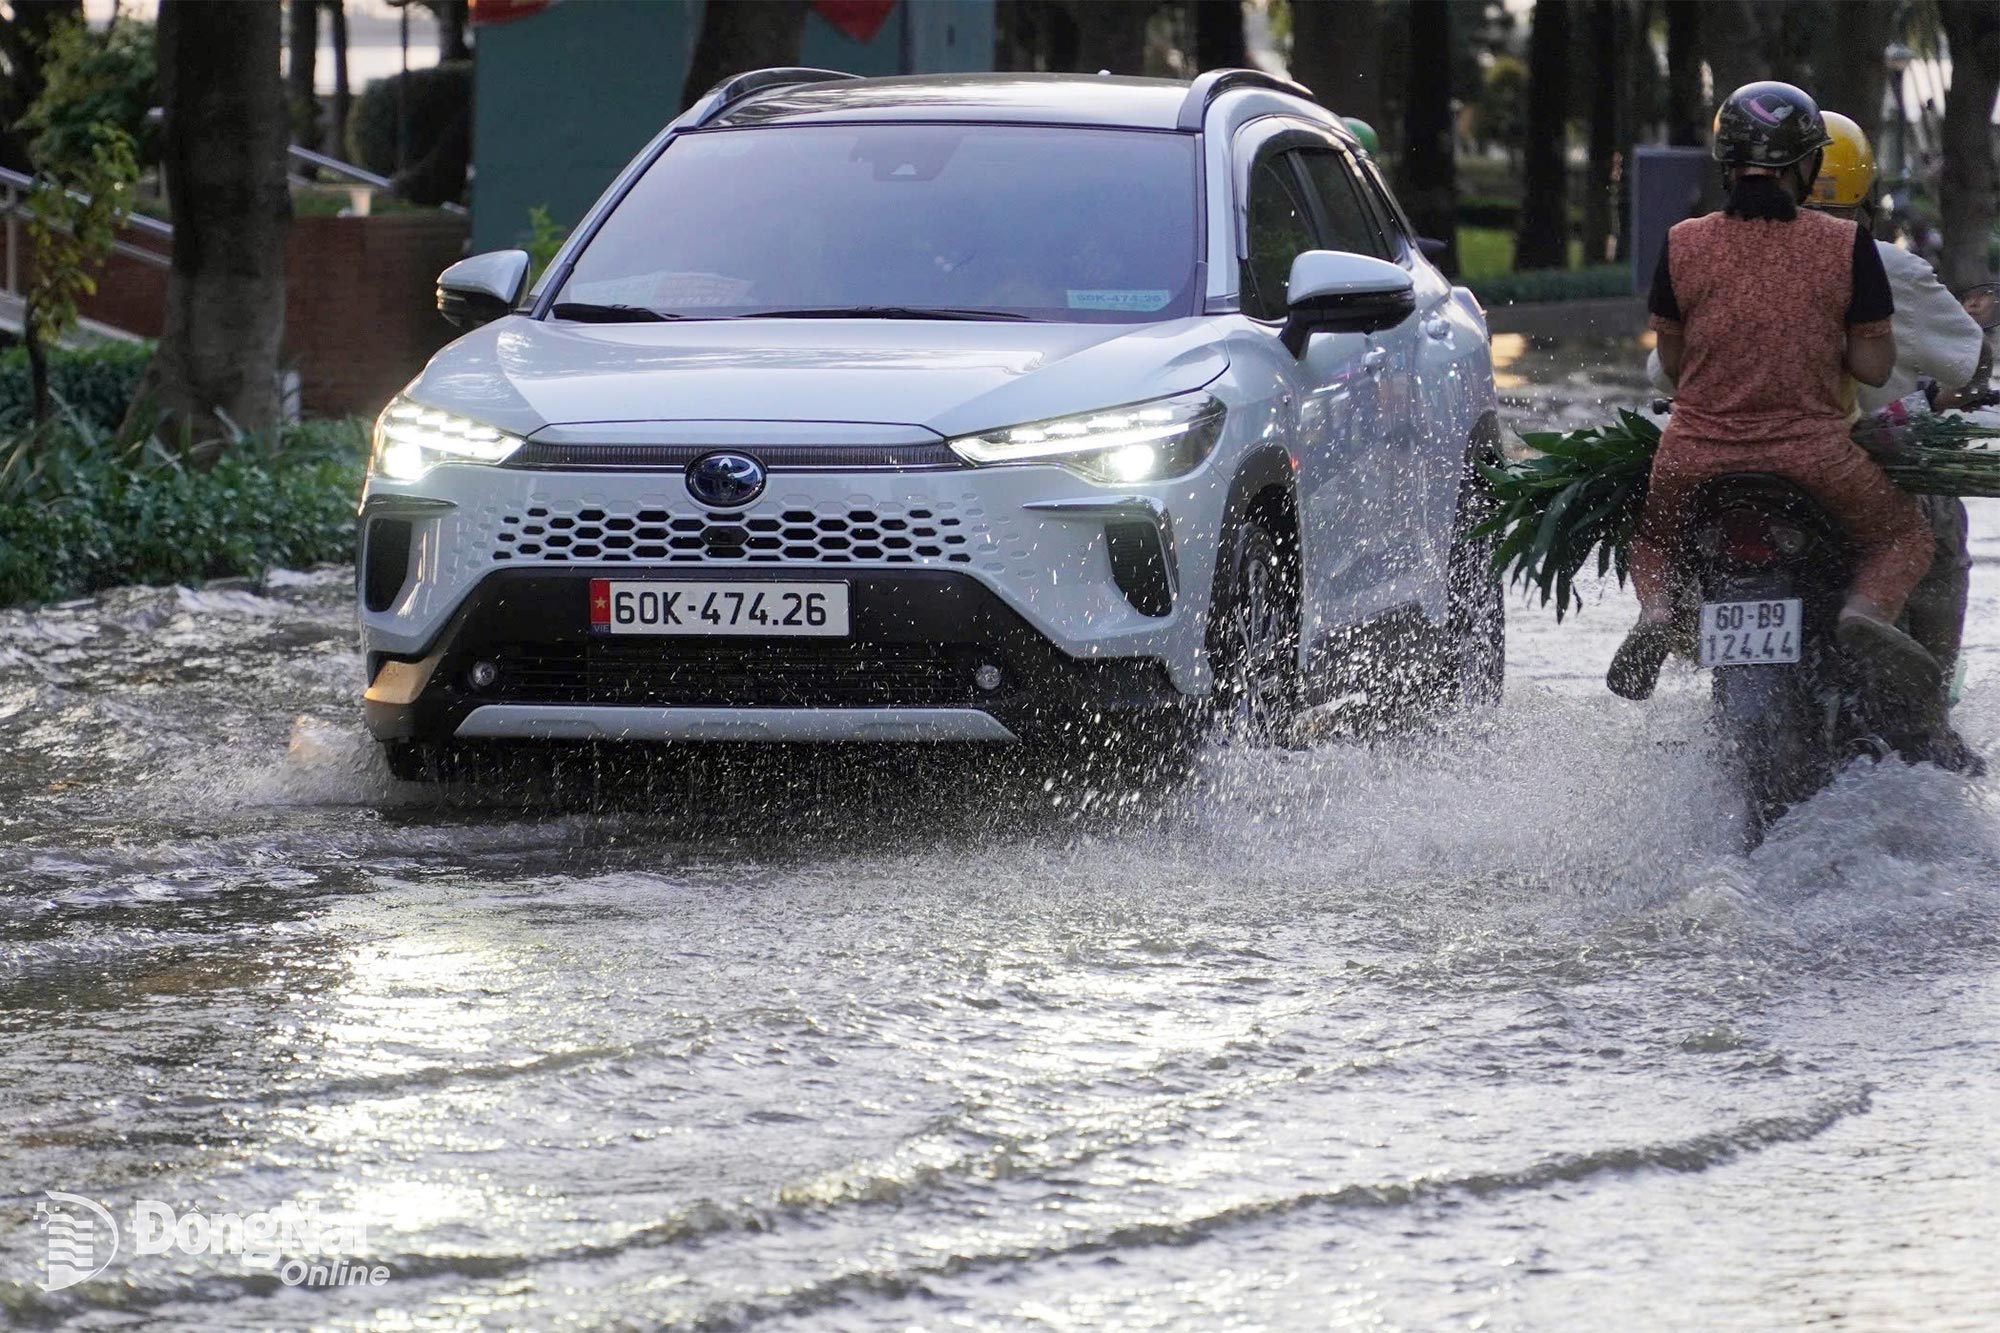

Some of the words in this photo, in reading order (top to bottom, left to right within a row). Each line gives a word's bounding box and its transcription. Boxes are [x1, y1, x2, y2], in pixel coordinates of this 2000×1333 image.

[614, 592, 827, 626] 60K-474.26
[1715, 602, 1786, 631] 60-B9
[593, 624, 610, 633] VIE
[1706, 631, 1794, 661] 124.44
